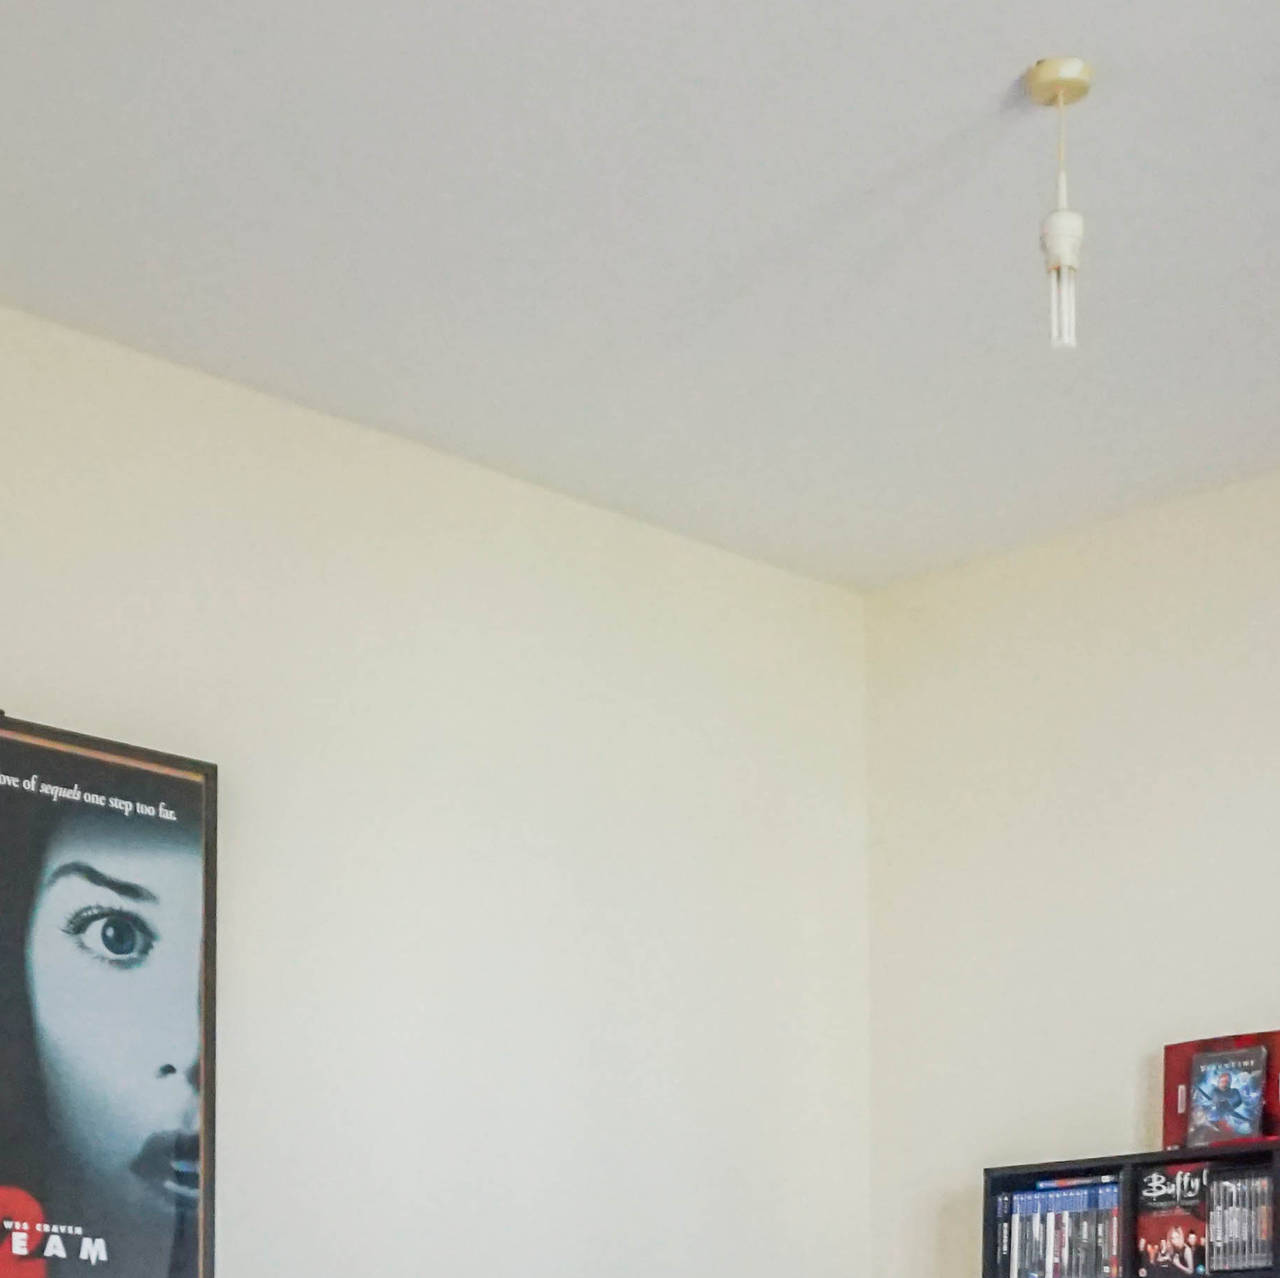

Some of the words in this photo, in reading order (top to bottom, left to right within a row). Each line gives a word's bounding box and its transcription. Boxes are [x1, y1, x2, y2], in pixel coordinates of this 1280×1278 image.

[22, 775, 38, 792] of
[40, 784, 82, 801] sequels
[83, 792, 106, 806] one
[109, 796, 133, 816] step
[136, 802, 156, 816] too
[159, 802, 177, 821] far.
[1142, 1171, 1200, 1204] Buffy
[3, 1220, 30, 1231] WES
[35, 1223, 83, 1235] CRAVEN
